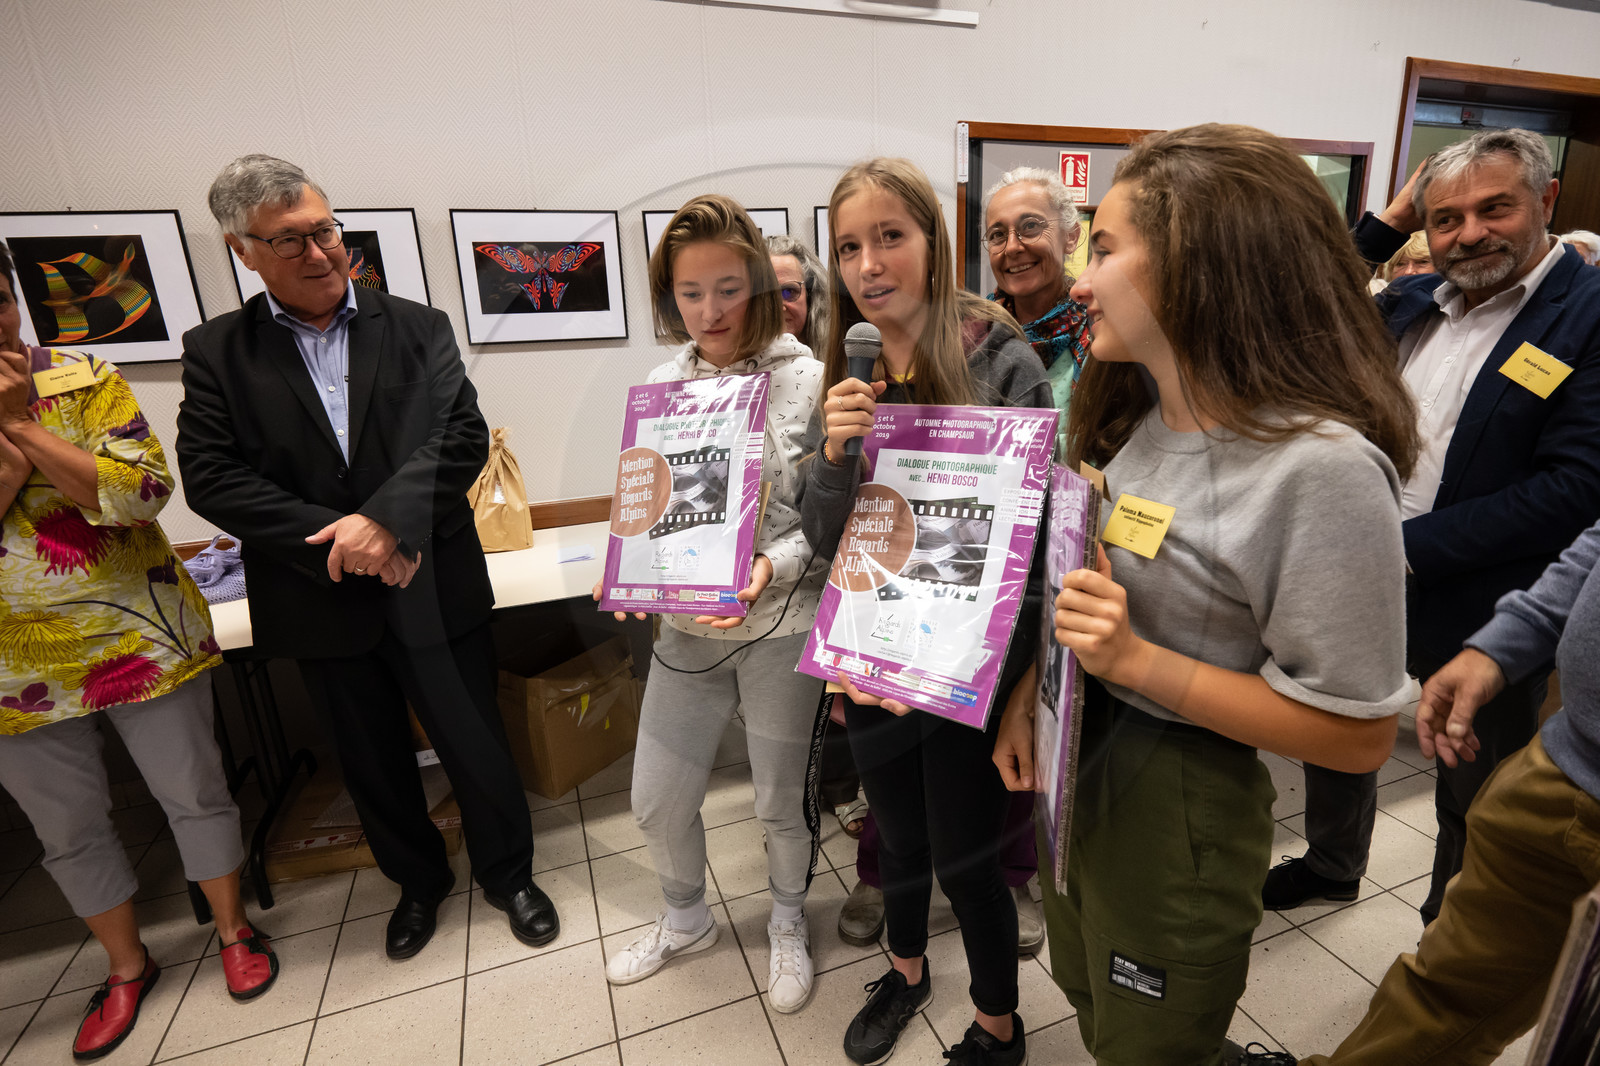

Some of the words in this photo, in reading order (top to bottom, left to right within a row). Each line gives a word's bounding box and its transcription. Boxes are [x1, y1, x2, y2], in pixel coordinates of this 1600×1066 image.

[914, 418, 941, 427] AUTOMNE
[929, 429, 937, 438] EN
[938, 430, 975, 439] CHAMPSAUR
[621, 457, 654, 473] Mention
[897, 458, 930, 469] DIALOGUE
[932, 460, 998, 475] PHOTOGRAPHIQUE
[621, 471, 654, 491] Spéciale
[927, 472, 950, 484] HENRI
[952, 475, 978, 487] BOSCO
[621, 487, 653, 506] Regards
[854, 497, 894, 513] Mention
[620, 507, 647, 523] Alpins
[851, 516, 894, 536] Spéciale
[953, 688, 978, 701] biocoop
